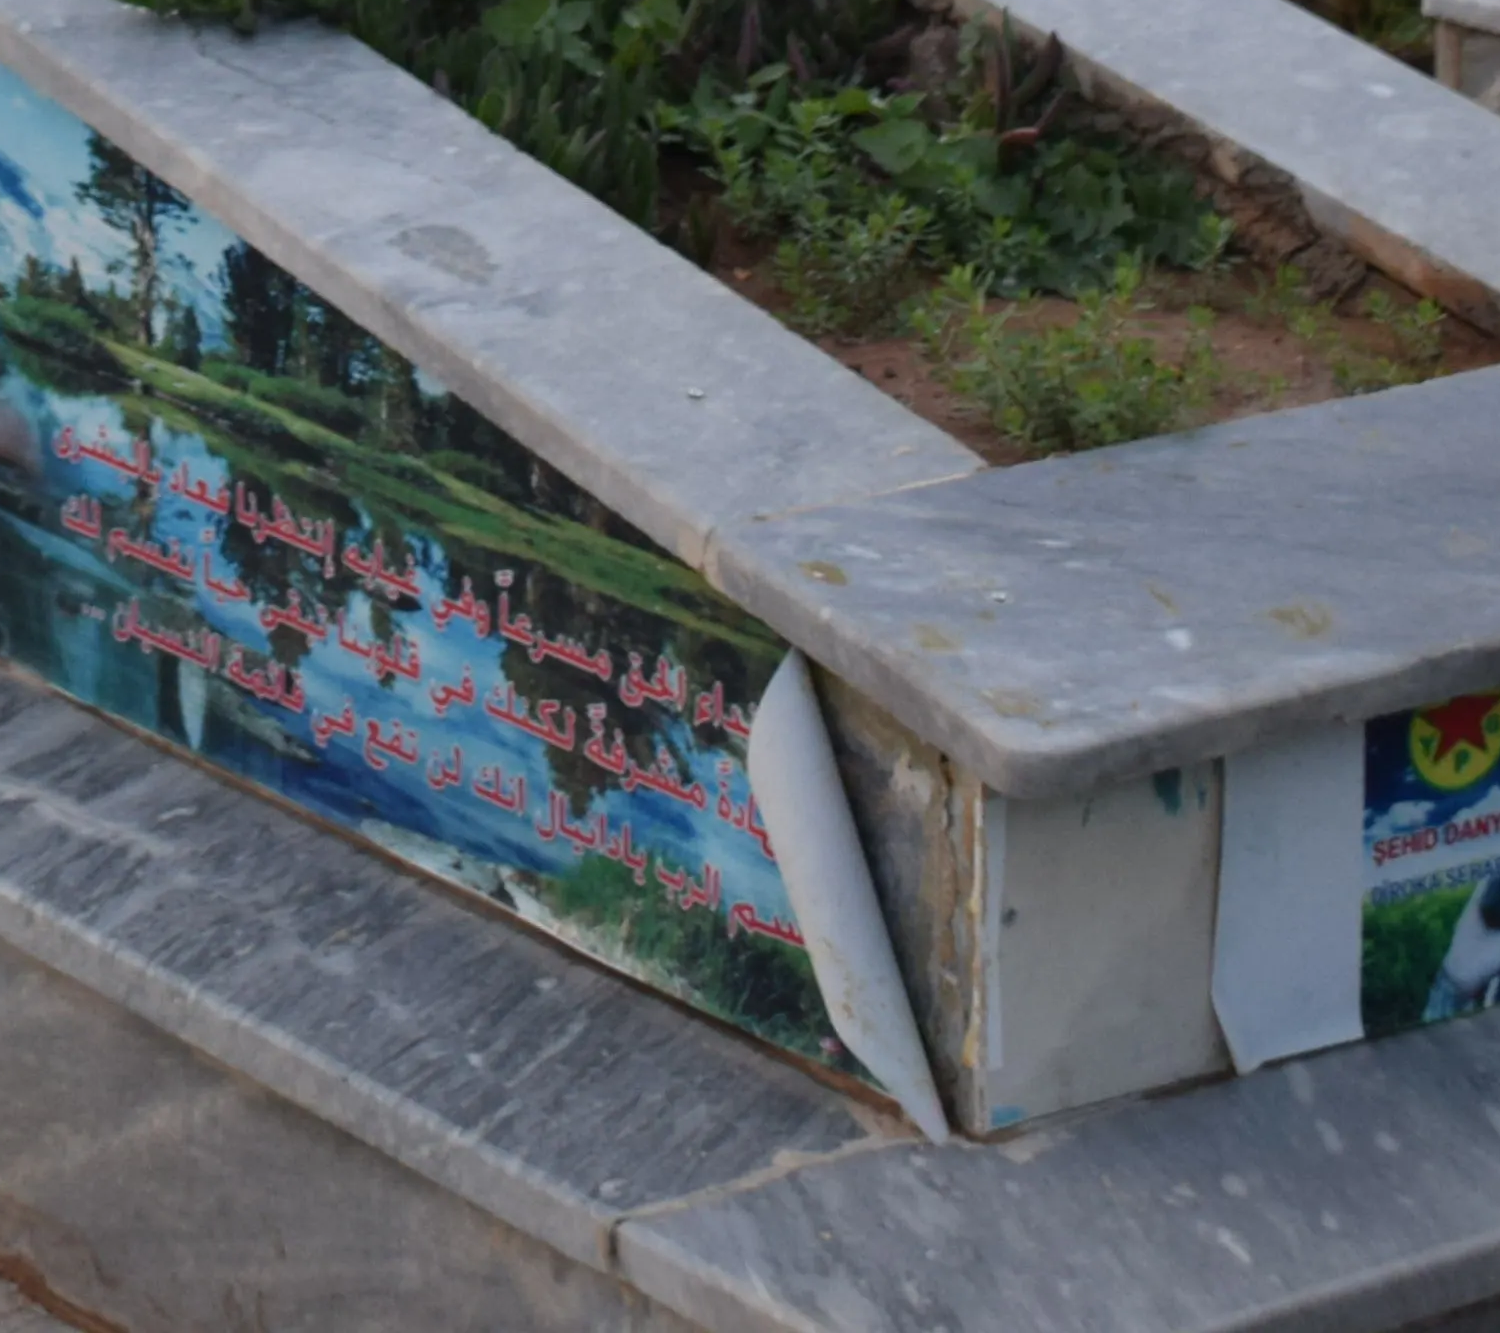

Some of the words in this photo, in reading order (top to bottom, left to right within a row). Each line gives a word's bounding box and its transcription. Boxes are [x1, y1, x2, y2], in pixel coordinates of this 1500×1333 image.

[61, 493, 102, 539] لك
[106, 527, 196, 582] نقسم
[341, 537, 421, 599] غيابه
[112, 596, 221, 672] النسيان
[430, 575, 491, 636] وفي
[337, 607, 421, 681] قلوبنا
[429, 664, 476, 715] في
[619, 650, 687, 712] الحق
[310, 694, 356, 748] في
[483, 680, 577, 752] لكنك
[425, 744, 463, 791] لن
[472, 757, 527, 817] انك
[654, 858, 722, 911] الرب
